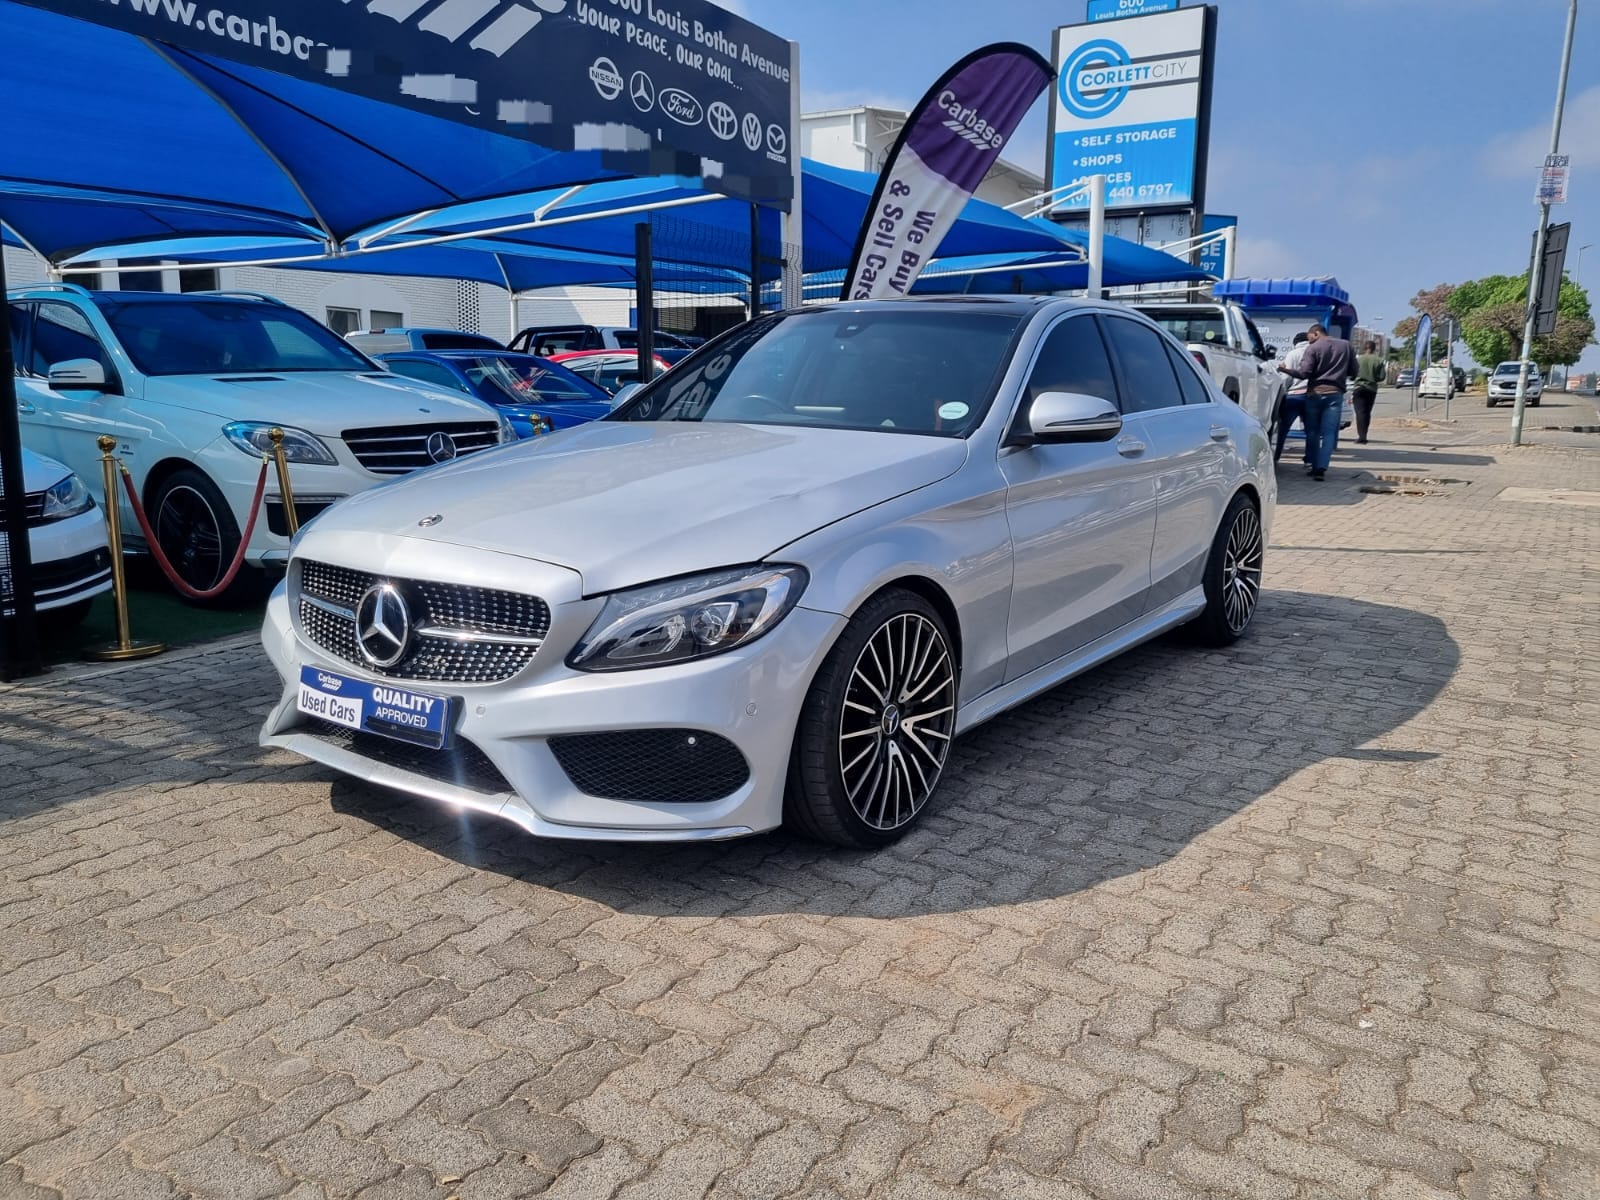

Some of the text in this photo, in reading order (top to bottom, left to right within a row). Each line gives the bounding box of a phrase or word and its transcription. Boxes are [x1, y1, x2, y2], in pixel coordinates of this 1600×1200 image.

[647, 0, 790, 83] Louis Botha Avenue
[676, 43, 704, 71] OUR
[591, 69, 622, 88] NISSAN
[667, 92, 696, 119] Ford
[938, 90, 1003, 149] Carbase
[1081, 127, 1177, 147] SELF STORAGE
[1080, 153, 1123, 167] SHOPS
[889, 180, 911, 197] &
[1109, 185, 1135, 200] 440
[1138, 183, 1174, 199] 6797
[873, 203, 904, 249] Sell
[889, 210, 936, 294] We Buy
[318, 672, 342, 688] Carbase
[301, 690, 355, 723] Used Cars
[372, 687, 435, 714] QUALITY
[375, 706, 428, 728] APPROVED
